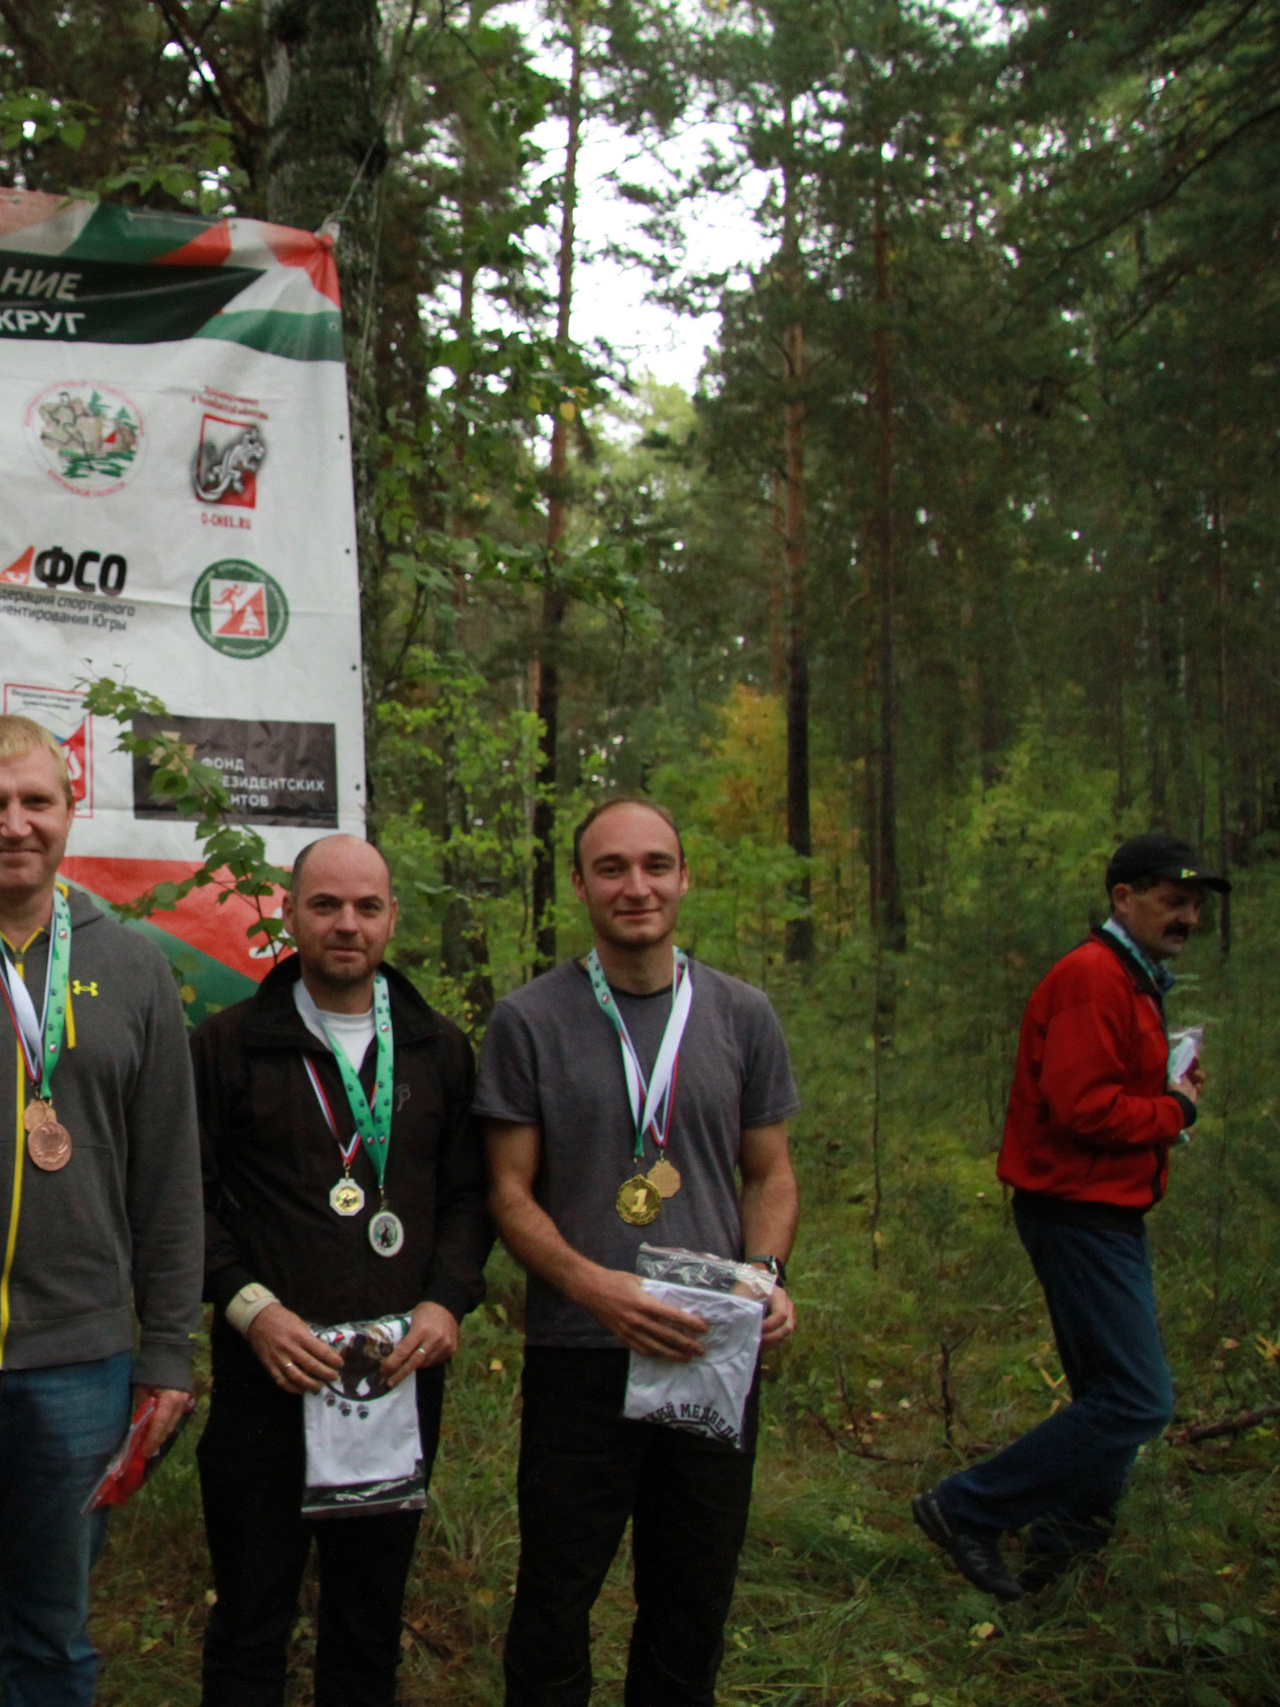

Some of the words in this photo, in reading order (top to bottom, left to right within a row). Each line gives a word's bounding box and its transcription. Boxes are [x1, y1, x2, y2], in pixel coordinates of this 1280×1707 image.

[34, 545, 127, 597] ФСО
[57, 595, 135, 617] спортивного
[92, 614, 127, 632] Югры
[201, 756, 245, 772] ФОНД
[222, 775, 325, 793] ЕЗИДЕНТСКИХ
[631, 1188, 648, 1214] 1
